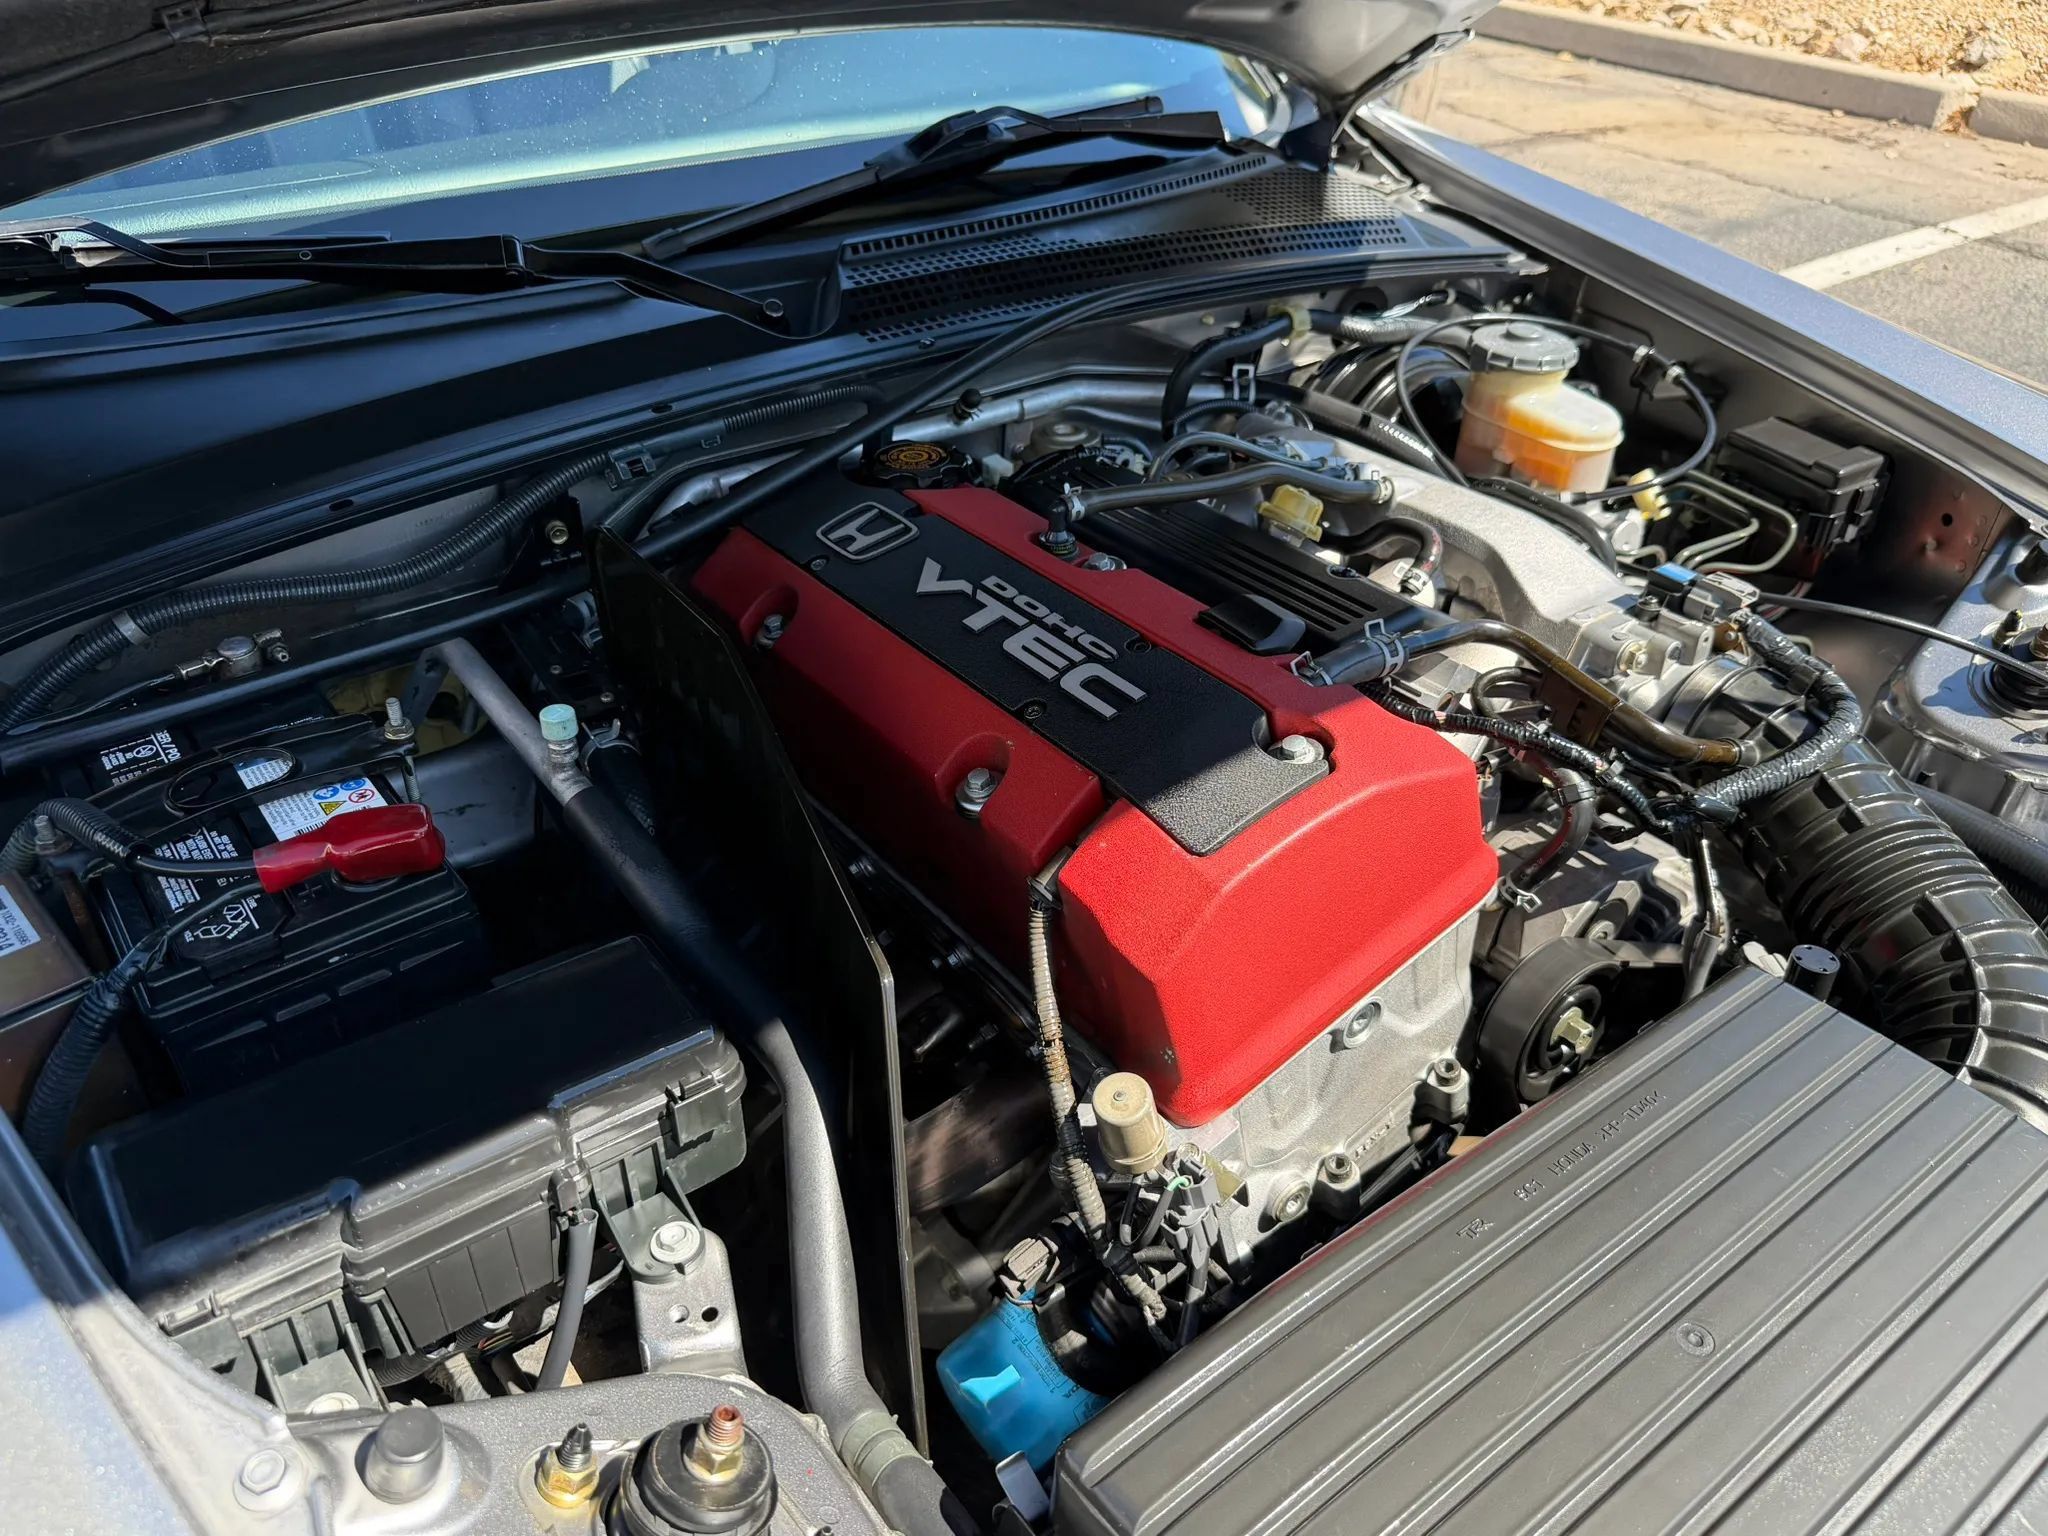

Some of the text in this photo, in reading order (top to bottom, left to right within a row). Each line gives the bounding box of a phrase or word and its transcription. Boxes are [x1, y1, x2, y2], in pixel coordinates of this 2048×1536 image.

[916, 556, 1148, 721] VTEC
[980, 575, 1119, 663] DOHC
[1547, 1141, 1598, 1176] HONDA
